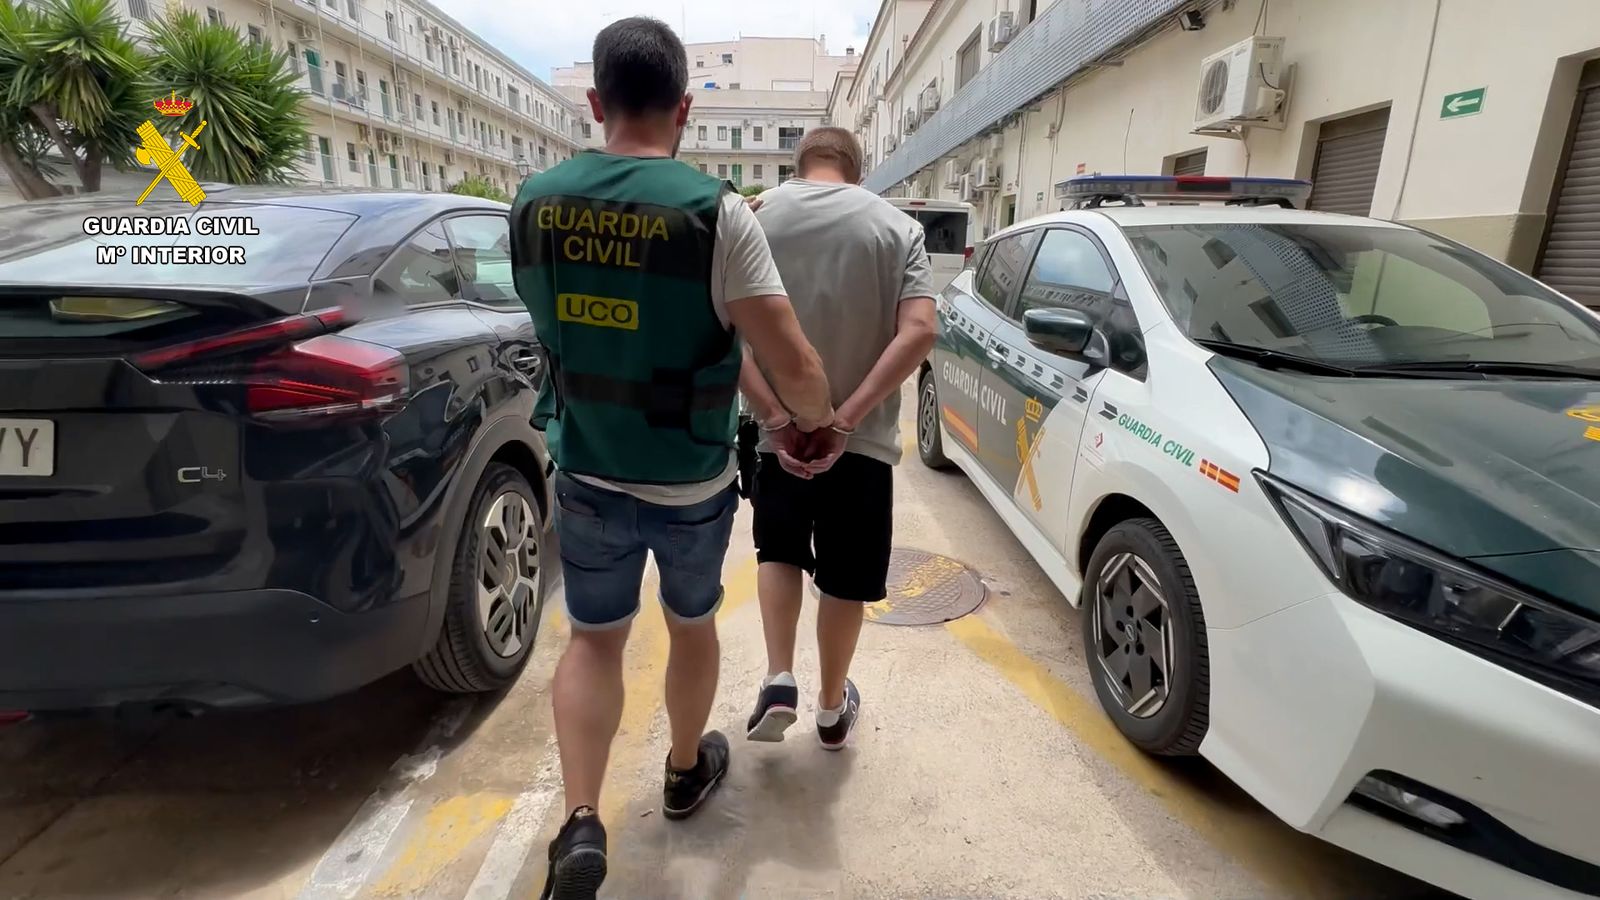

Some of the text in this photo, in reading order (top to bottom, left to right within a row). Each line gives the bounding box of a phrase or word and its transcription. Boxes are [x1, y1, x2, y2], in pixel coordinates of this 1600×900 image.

[538, 205, 669, 241] GUARDIA
[563, 235, 641, 267] CIVIL
[565, 297, 633, 323] UCO
[943, 361, 1007, 426] GUARDIA CIVIL
[0, 427, 39, 468] Y
[1118, 413, 1196, 467] GUARDIA CIVIL
[177, 466, 227, 483] C4
